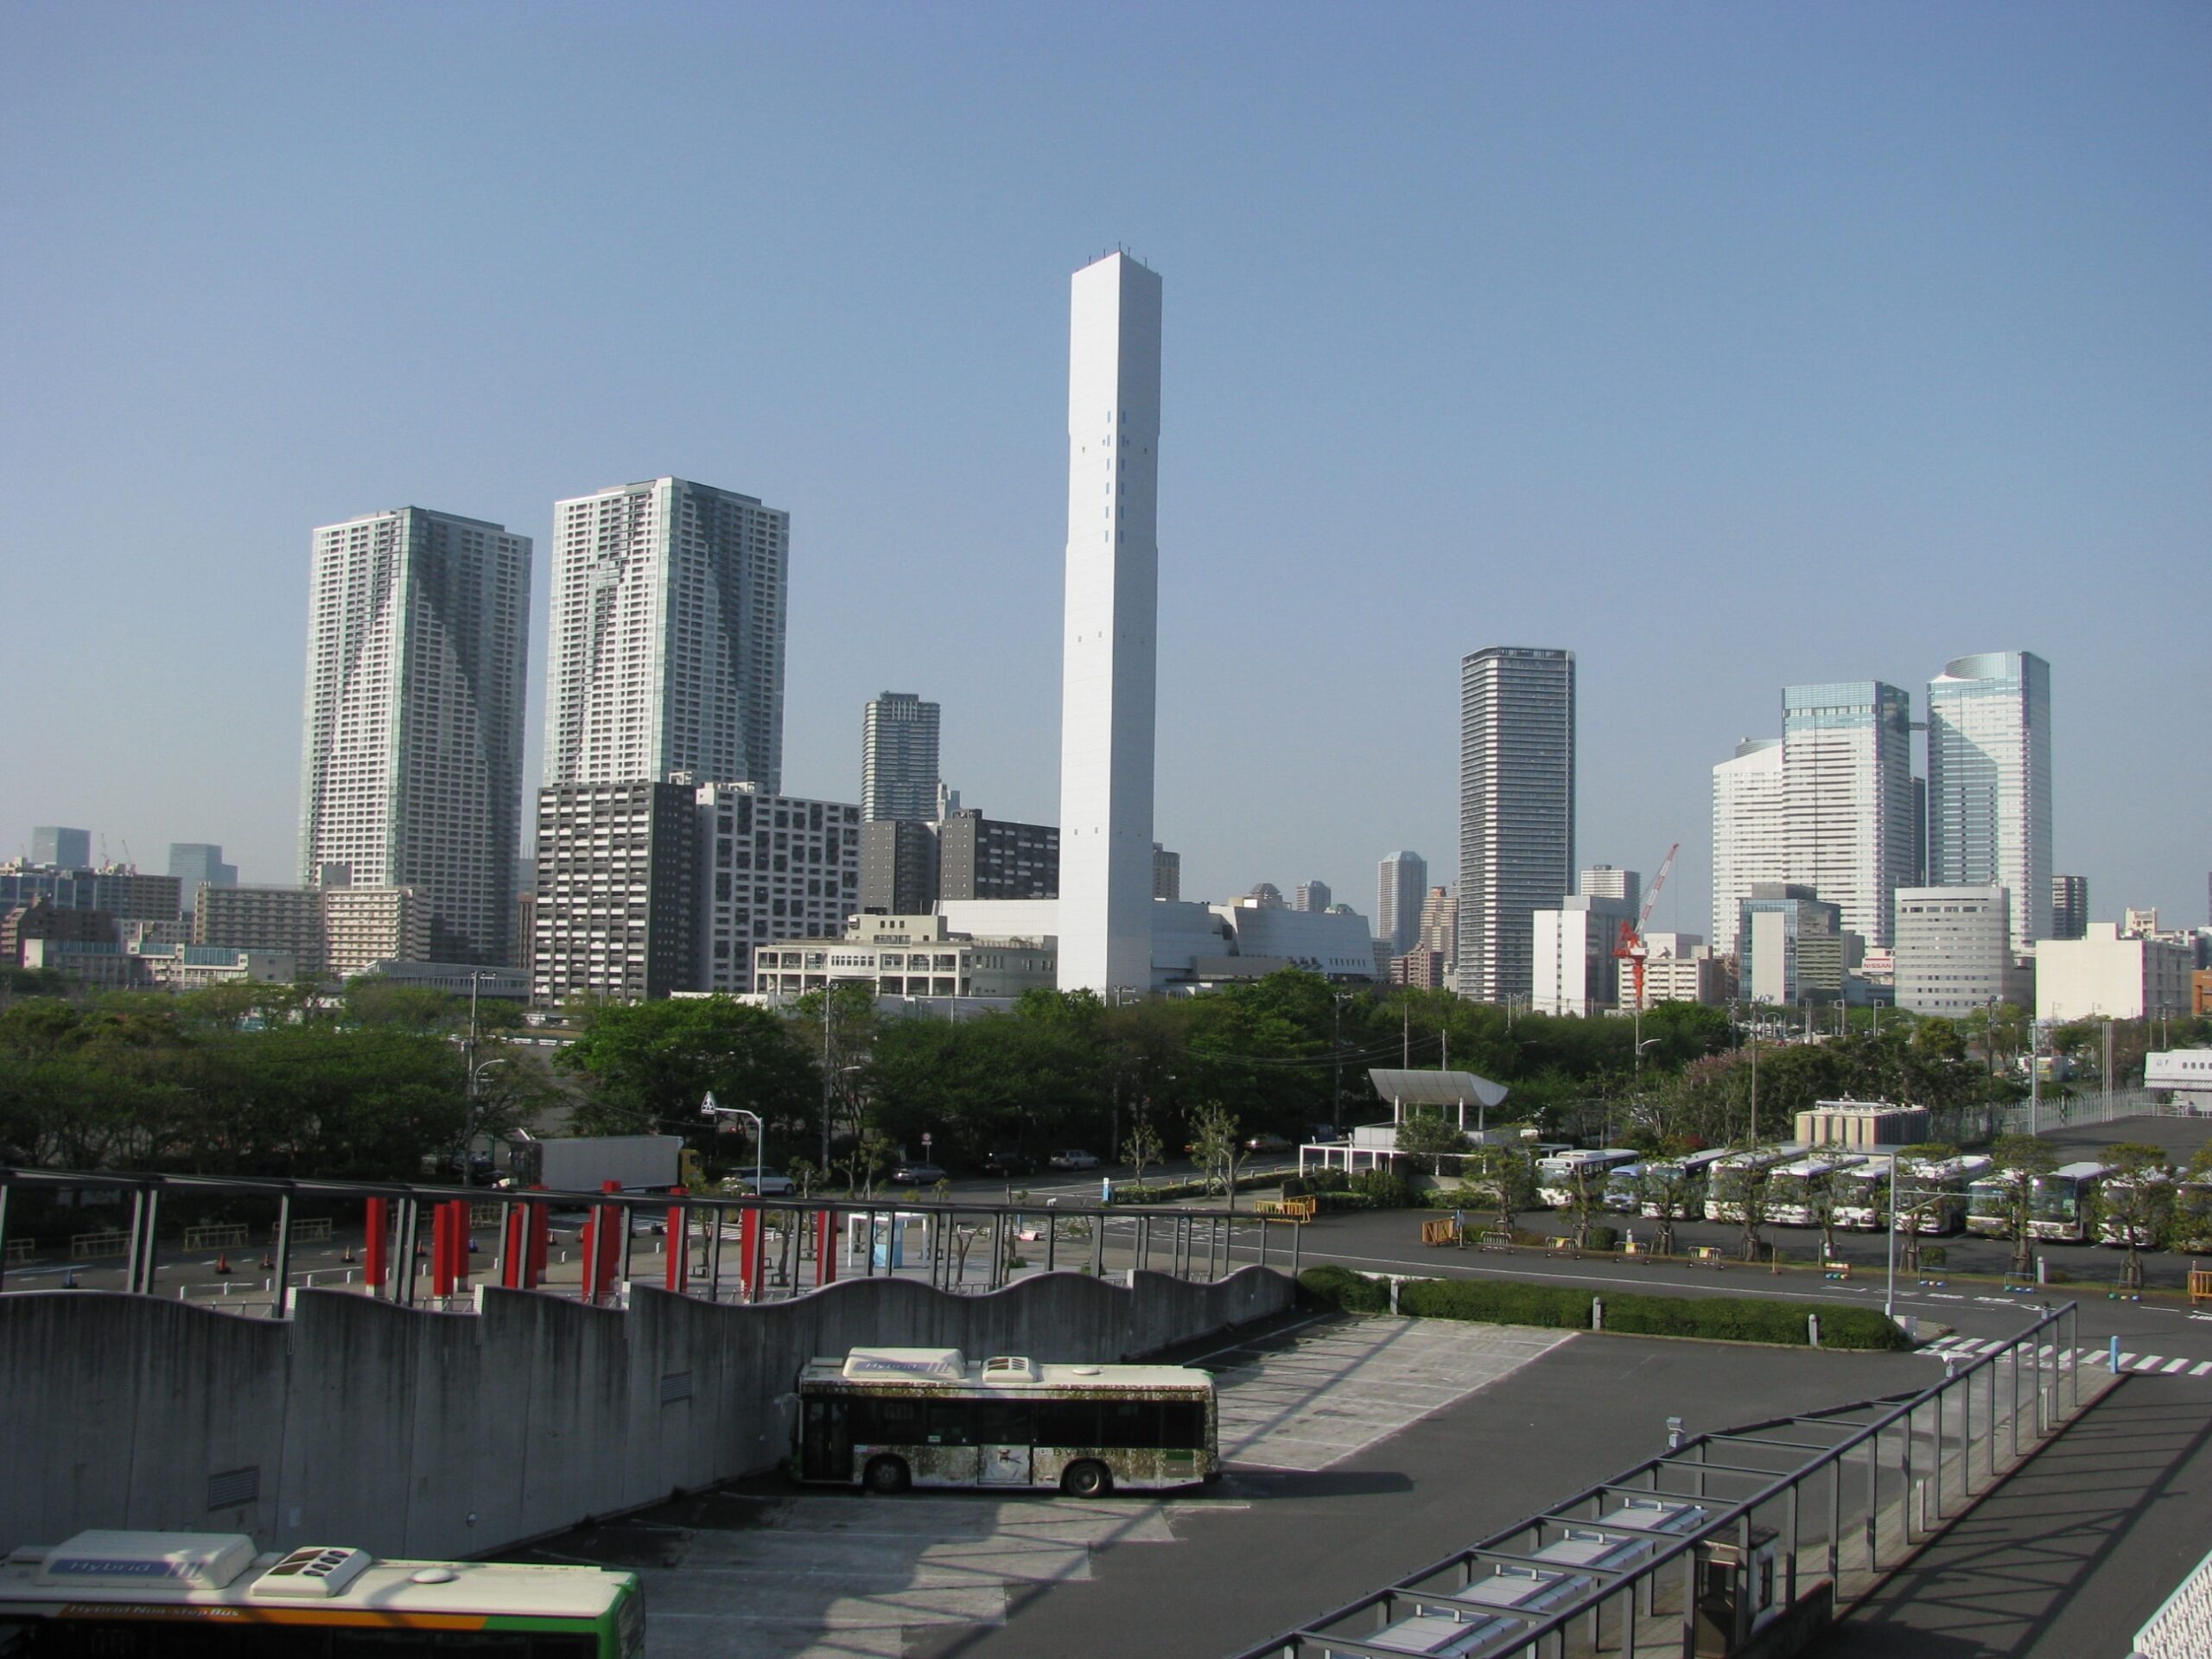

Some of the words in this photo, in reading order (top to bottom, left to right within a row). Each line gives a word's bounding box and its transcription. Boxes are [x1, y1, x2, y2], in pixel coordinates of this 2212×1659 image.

[69, 1561, 153, 1573] Hybrid
[69, 1605, 130, 1614] Hybrid
[209, 1608, 239, 1618] Bus
